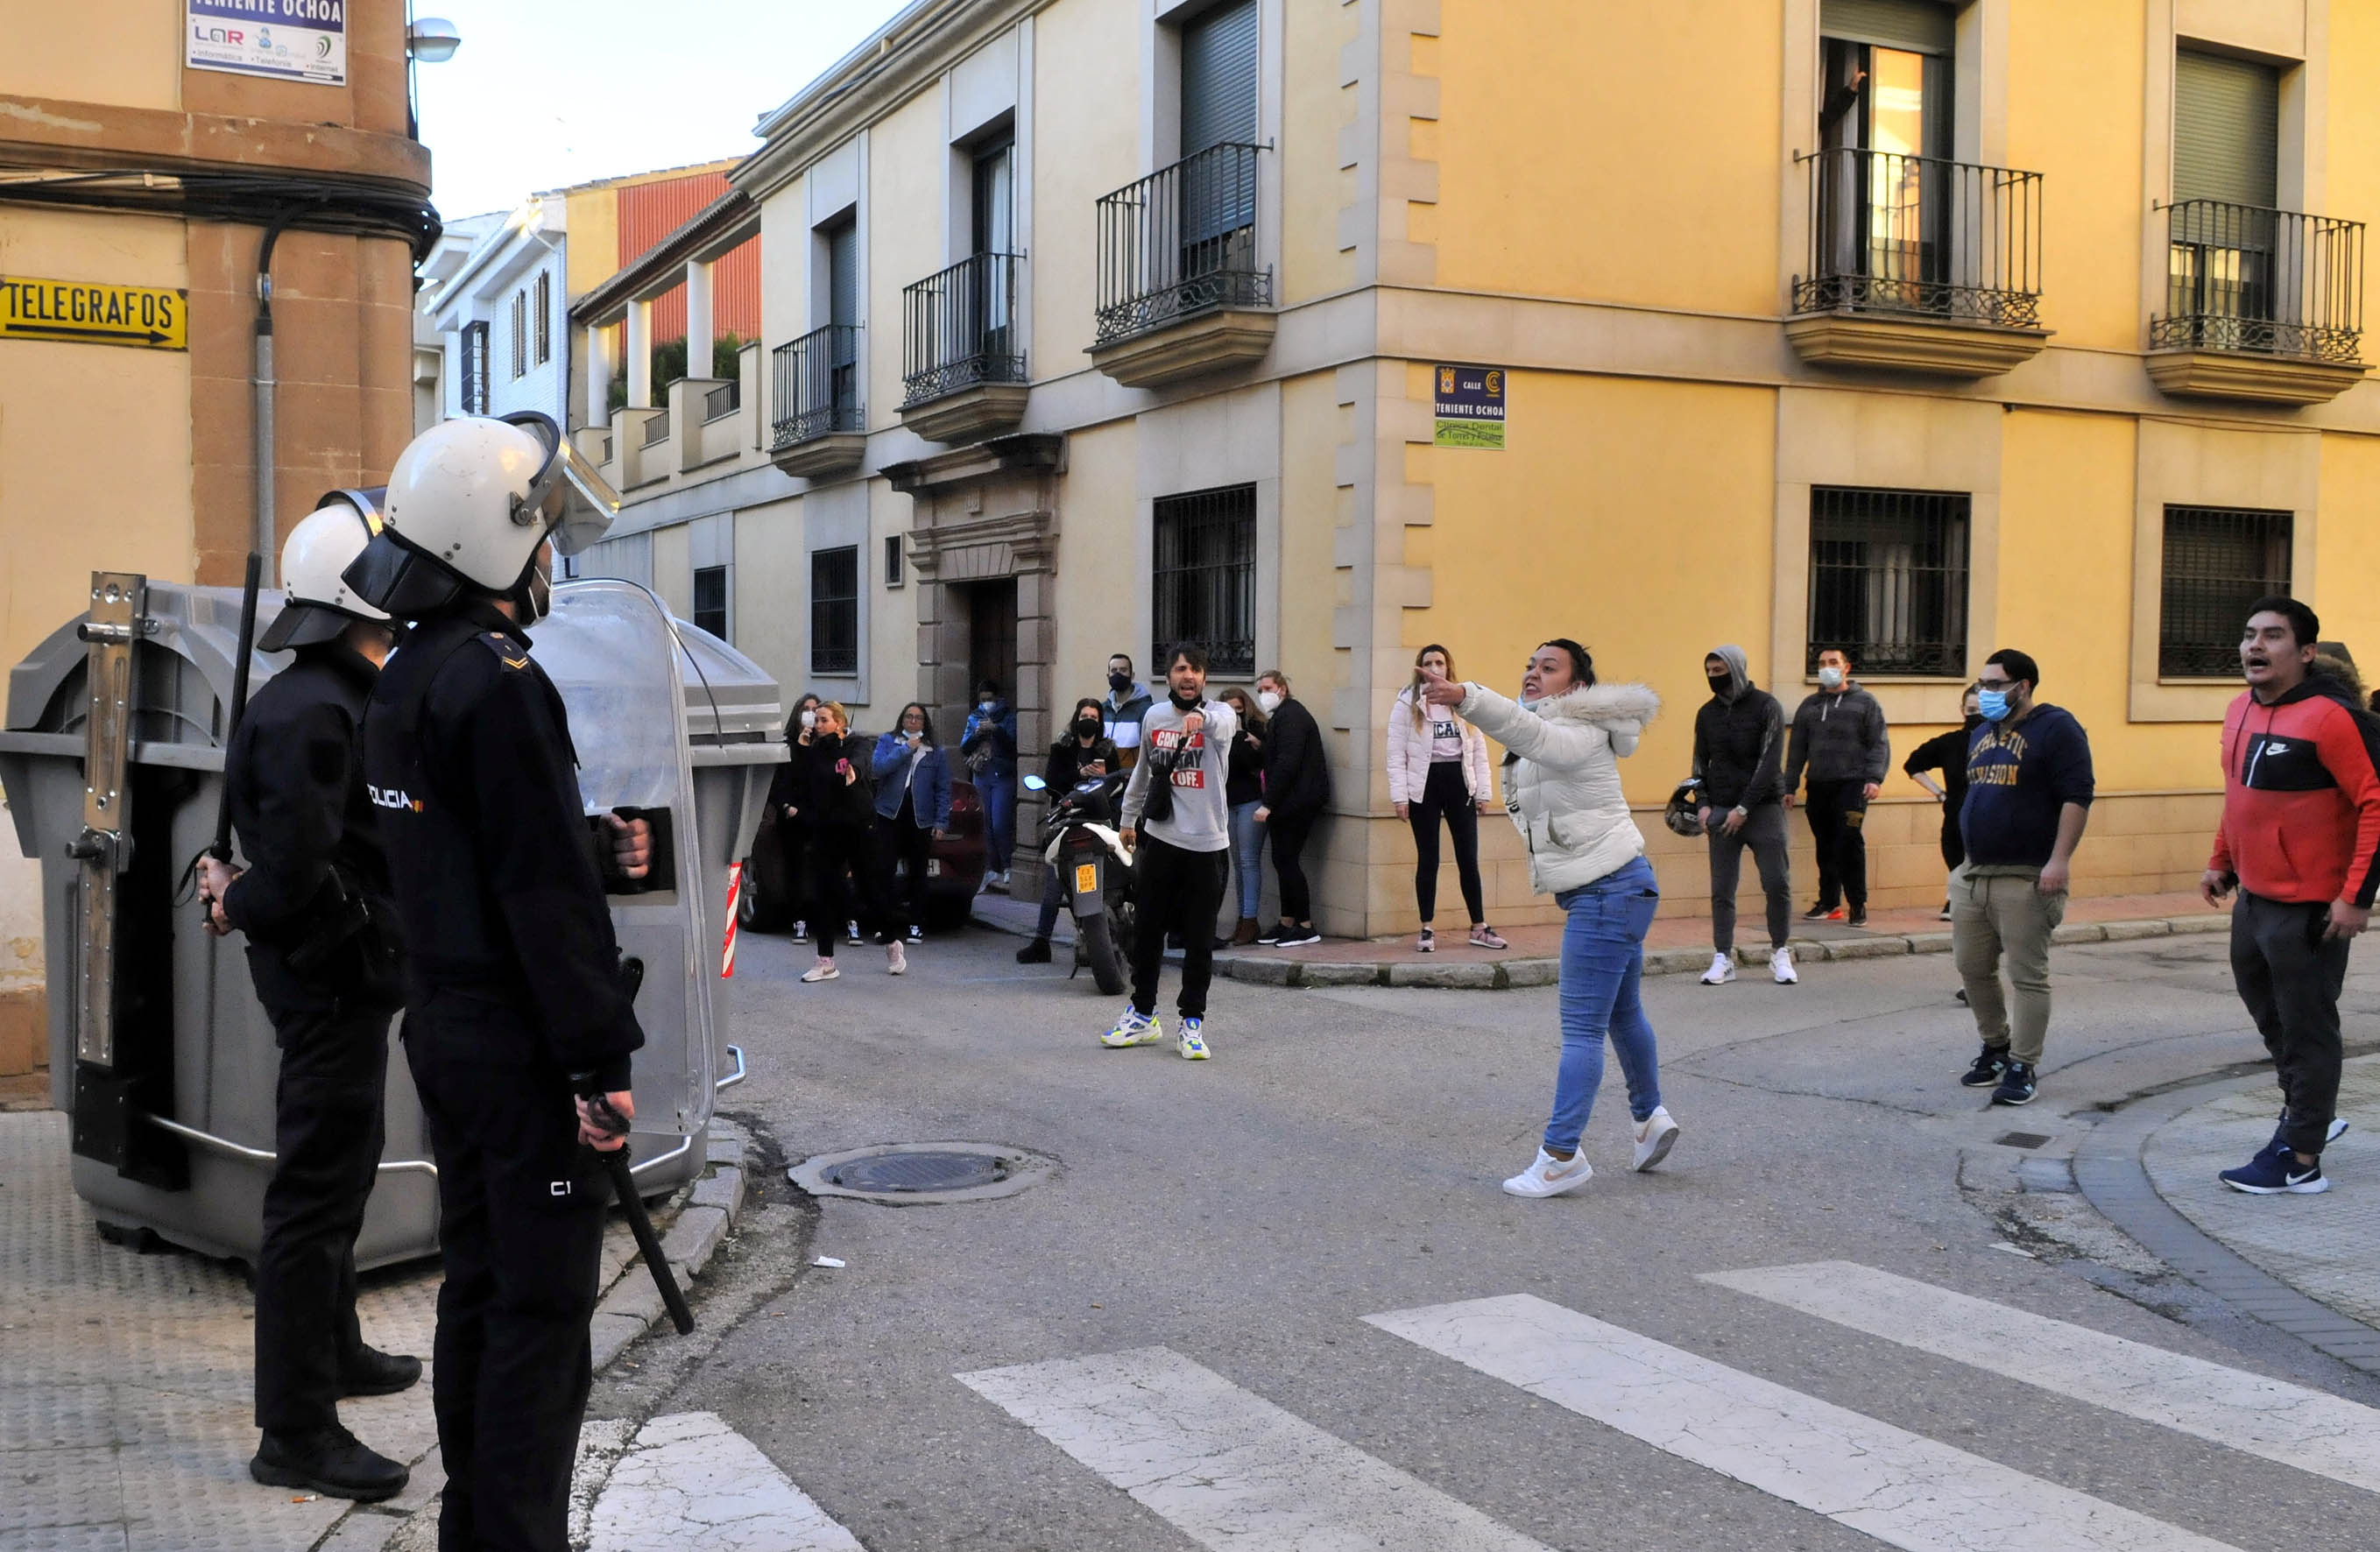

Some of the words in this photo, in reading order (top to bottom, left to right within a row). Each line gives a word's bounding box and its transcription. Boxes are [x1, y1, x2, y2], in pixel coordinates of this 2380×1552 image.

[281, 0, 342, 23] OCHOA
[4, 282, 172, 328] TELEGRAFOS
[1463, 381, 1481, 390] CALLE
[1436, 403, 1473, 415] TENIENTE
[1476, 405, 1504, 416] OCHOA
[367, 784, 413, 809] OLICIA
